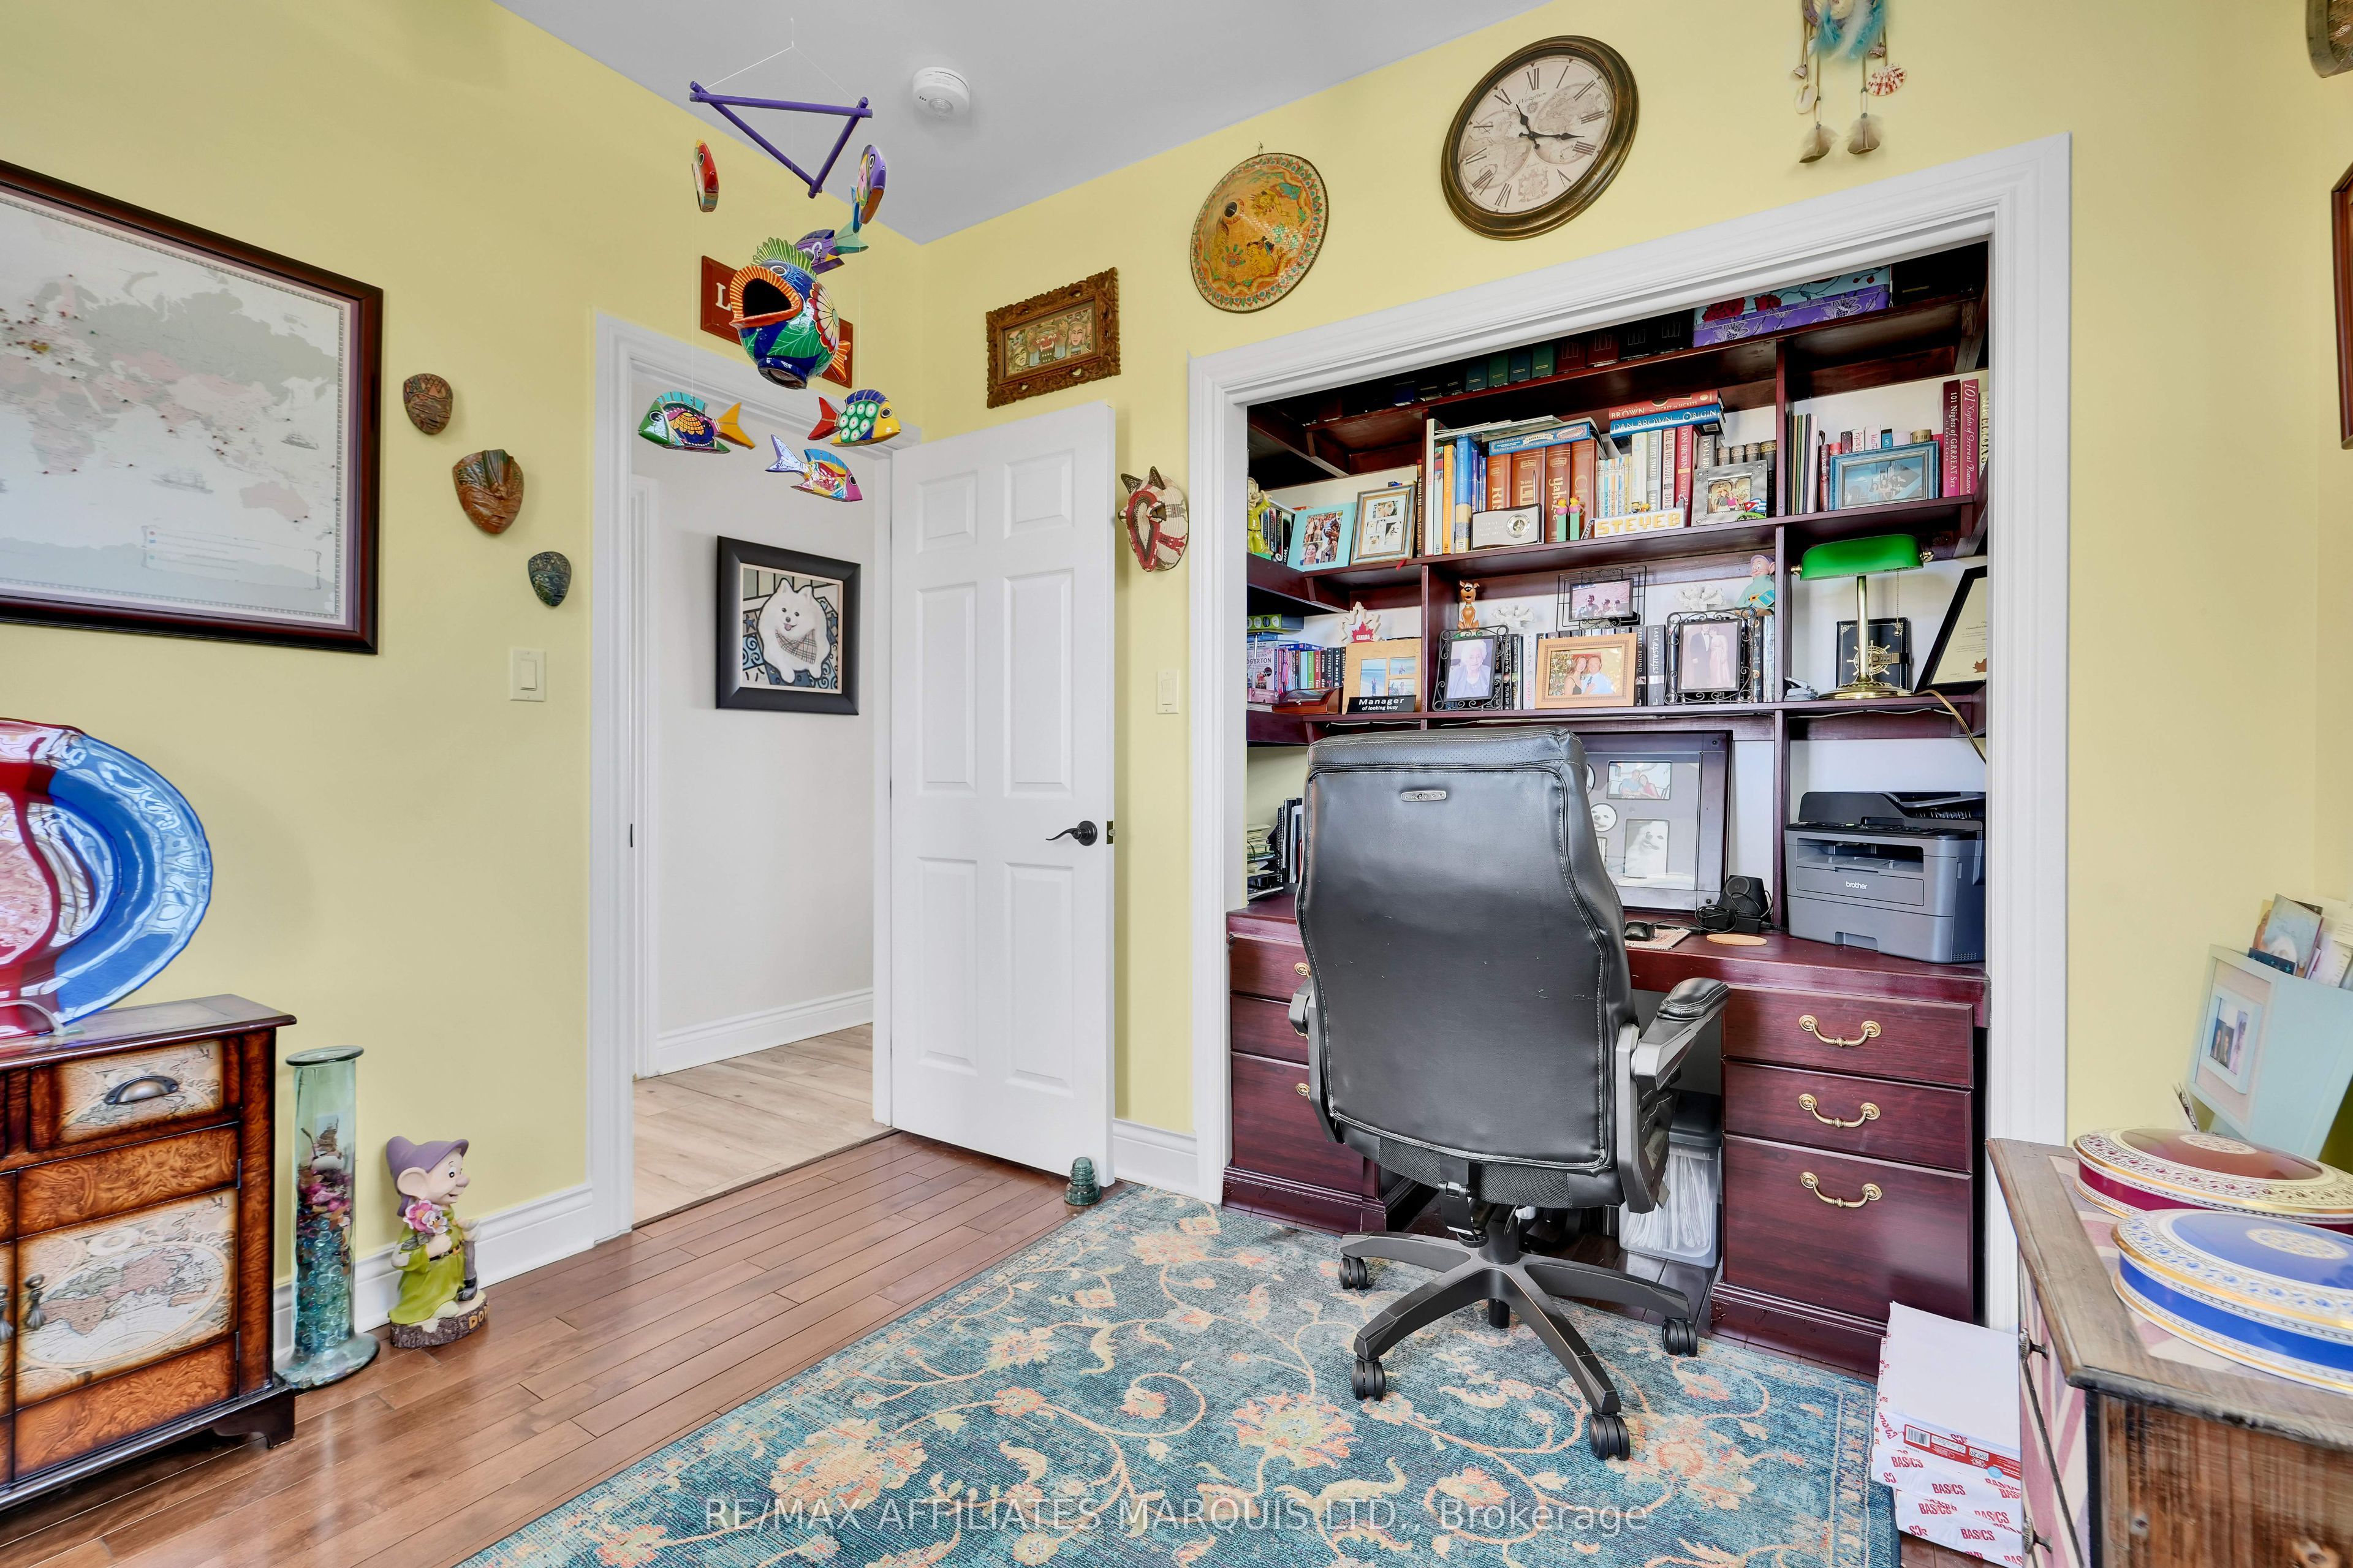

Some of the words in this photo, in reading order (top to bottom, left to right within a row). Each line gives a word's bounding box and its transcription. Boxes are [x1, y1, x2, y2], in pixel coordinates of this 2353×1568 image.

[1965, 384, 1976, 402] 101
[1611, 407, 1645, 419] BROWN
[1613, 422, 1634, 431] DAN
[1637, 415, 1673, 428] BROWN
[1682, 409, 1717, 422] ORIGIN
[1949, 405, 1958, 427] Nights
[1965, 403, 1975, 426] Nights
[1491, 487, 1504, 509] RIS
[1845, 881, 1868, 890] brother
